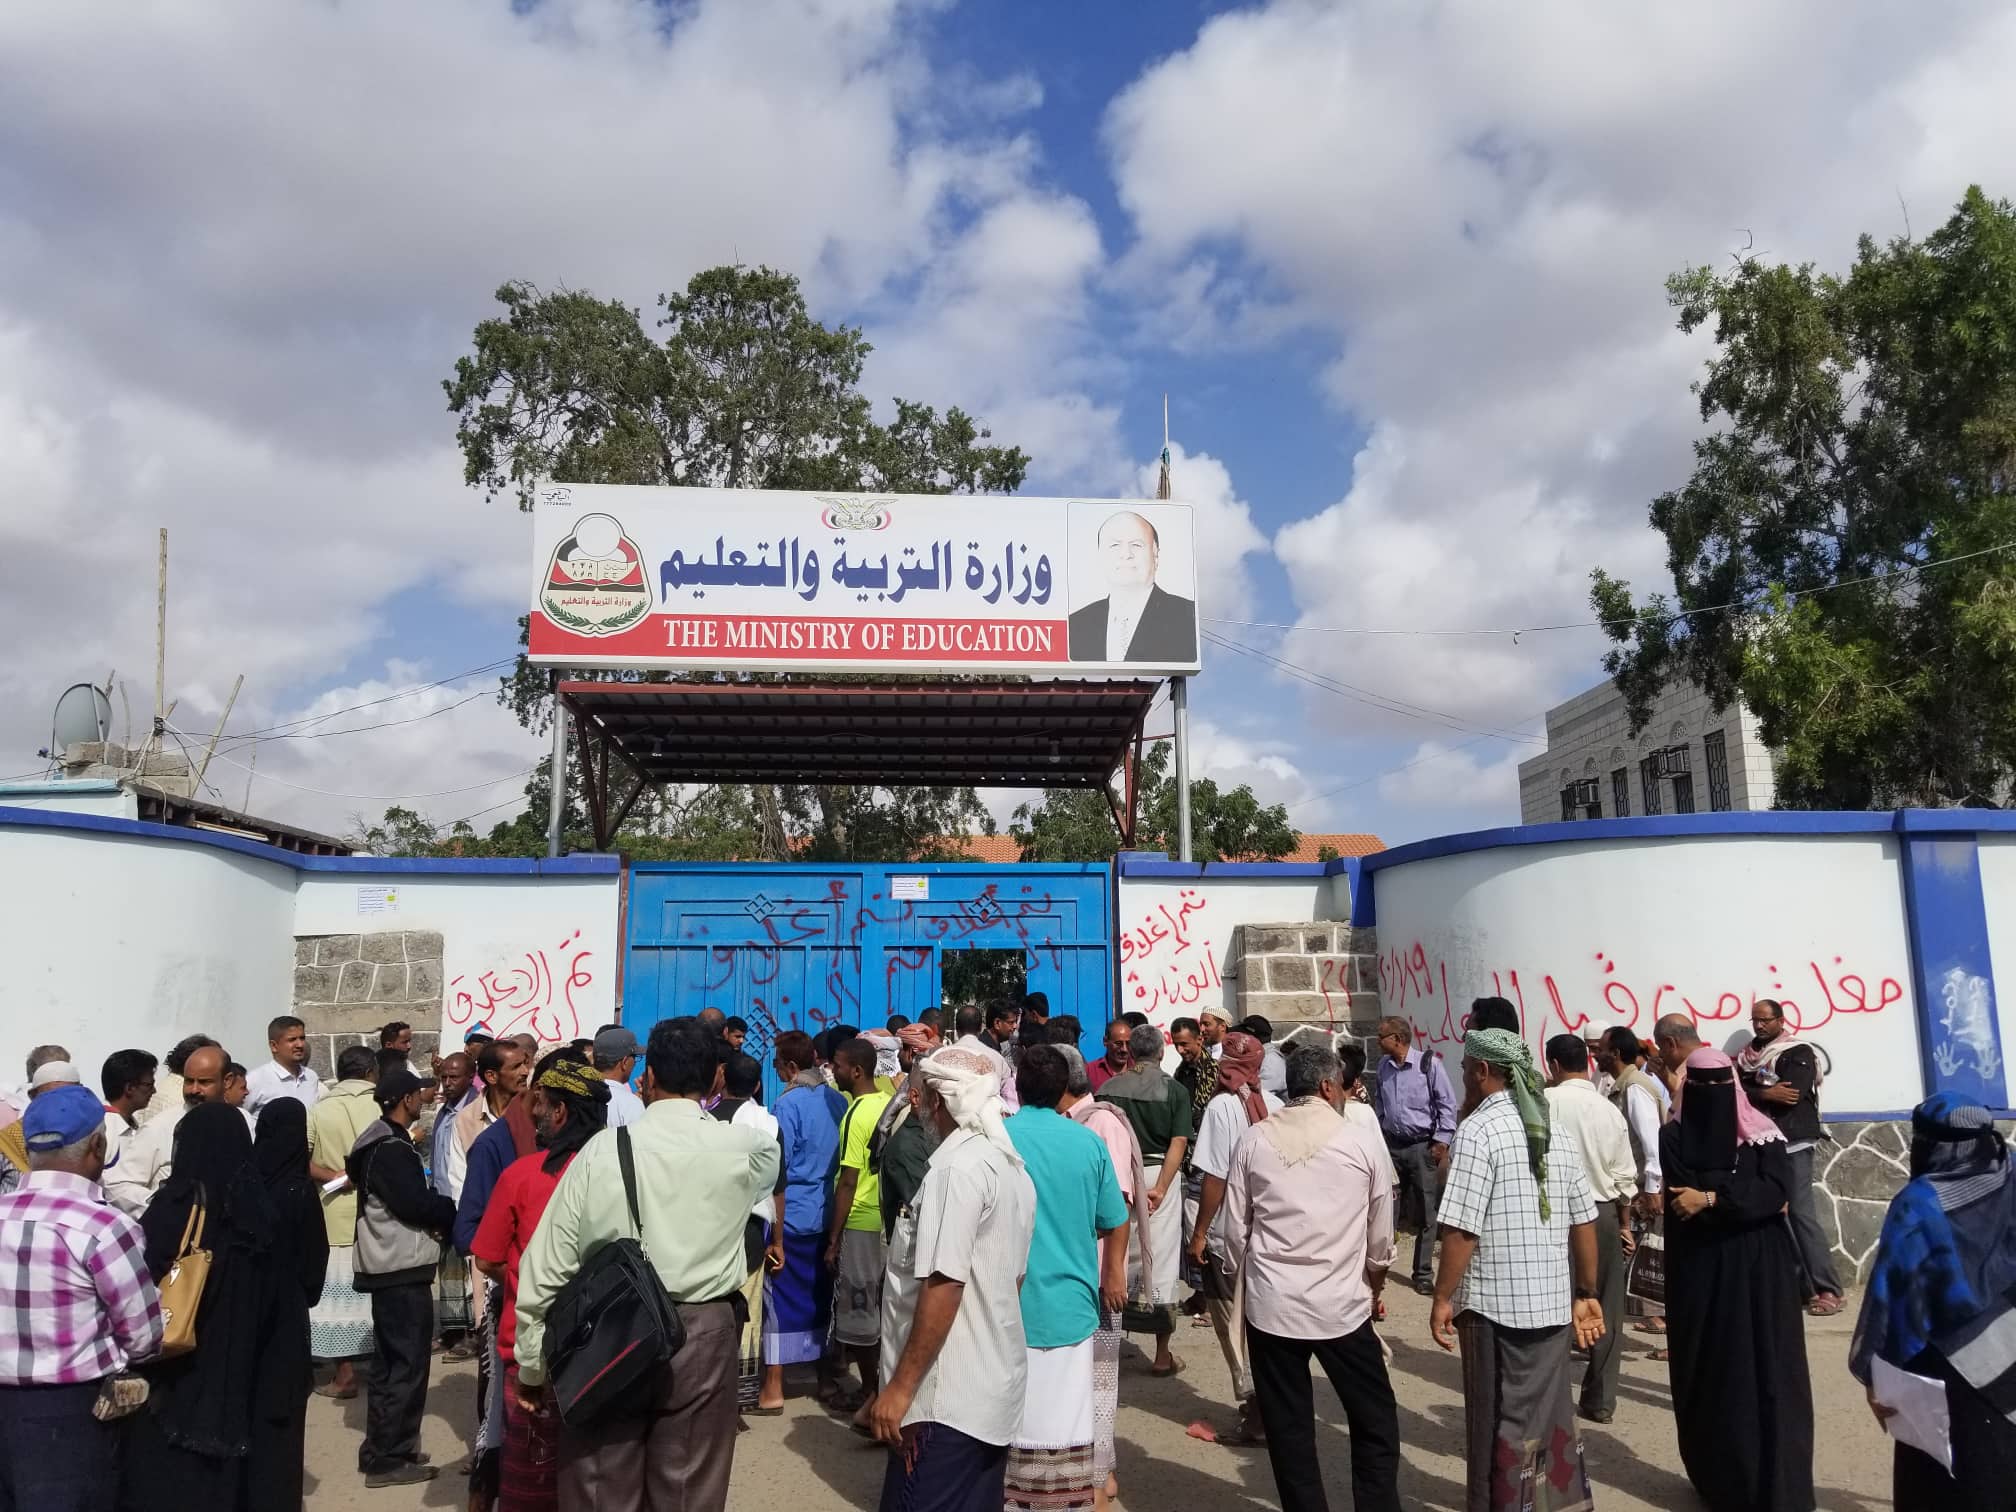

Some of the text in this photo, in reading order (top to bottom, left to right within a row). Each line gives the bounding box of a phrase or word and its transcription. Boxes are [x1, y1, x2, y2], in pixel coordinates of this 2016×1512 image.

[659, 536, 1053, 605] وزارة التربية والتعليم
[561, 596, 632, 606] وزارة التربية والتعليم
[664, 619, 1053, 652] THE MINISTRY OF EDUCATION
